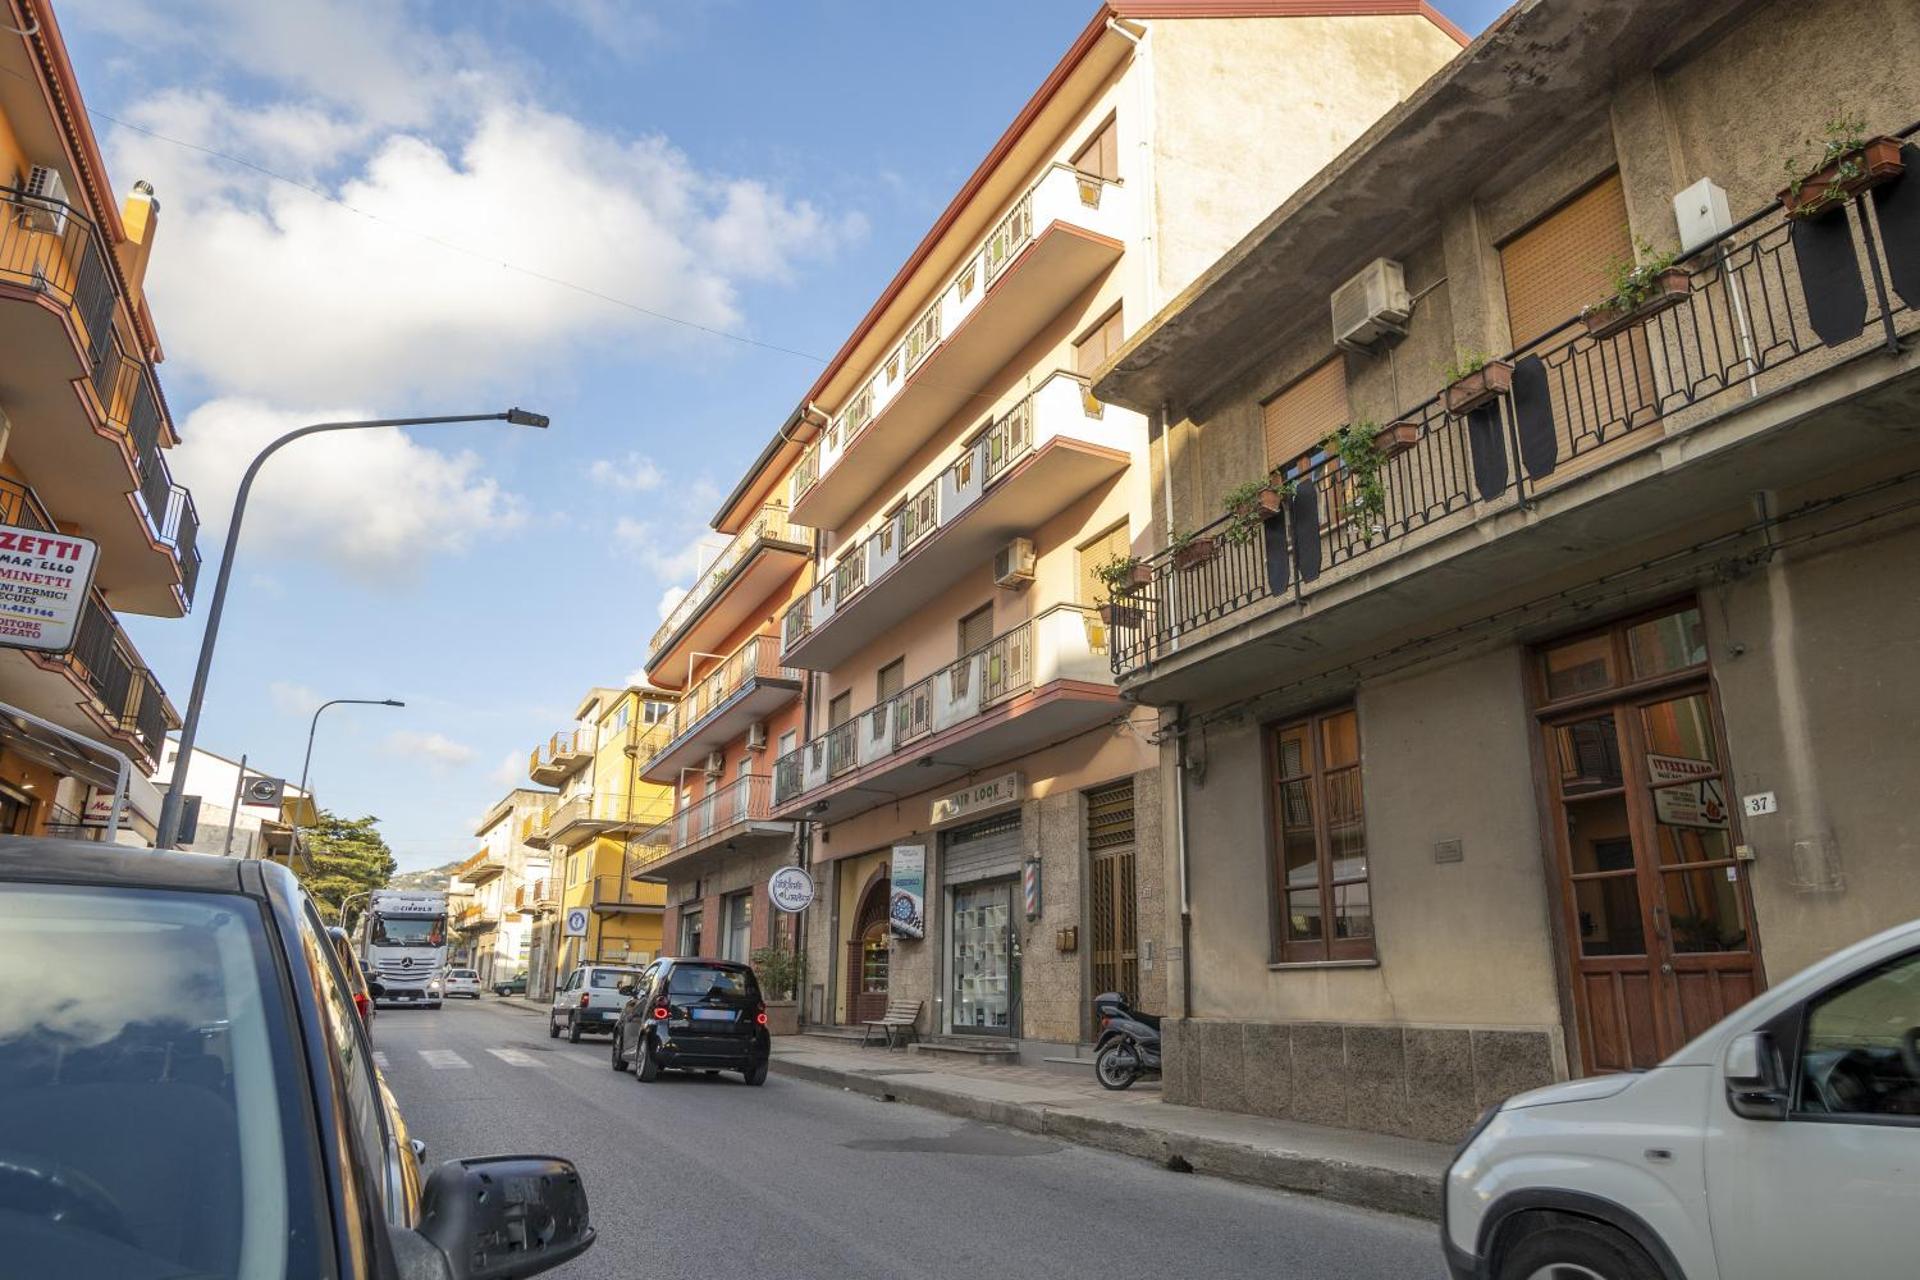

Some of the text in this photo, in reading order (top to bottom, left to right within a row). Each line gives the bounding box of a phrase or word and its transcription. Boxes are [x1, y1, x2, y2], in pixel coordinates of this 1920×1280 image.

[18, 586, 68, 600] TERMICI
[975, 783, 999, 803] LOOK
[1752, 797, 1767, 811] 37
